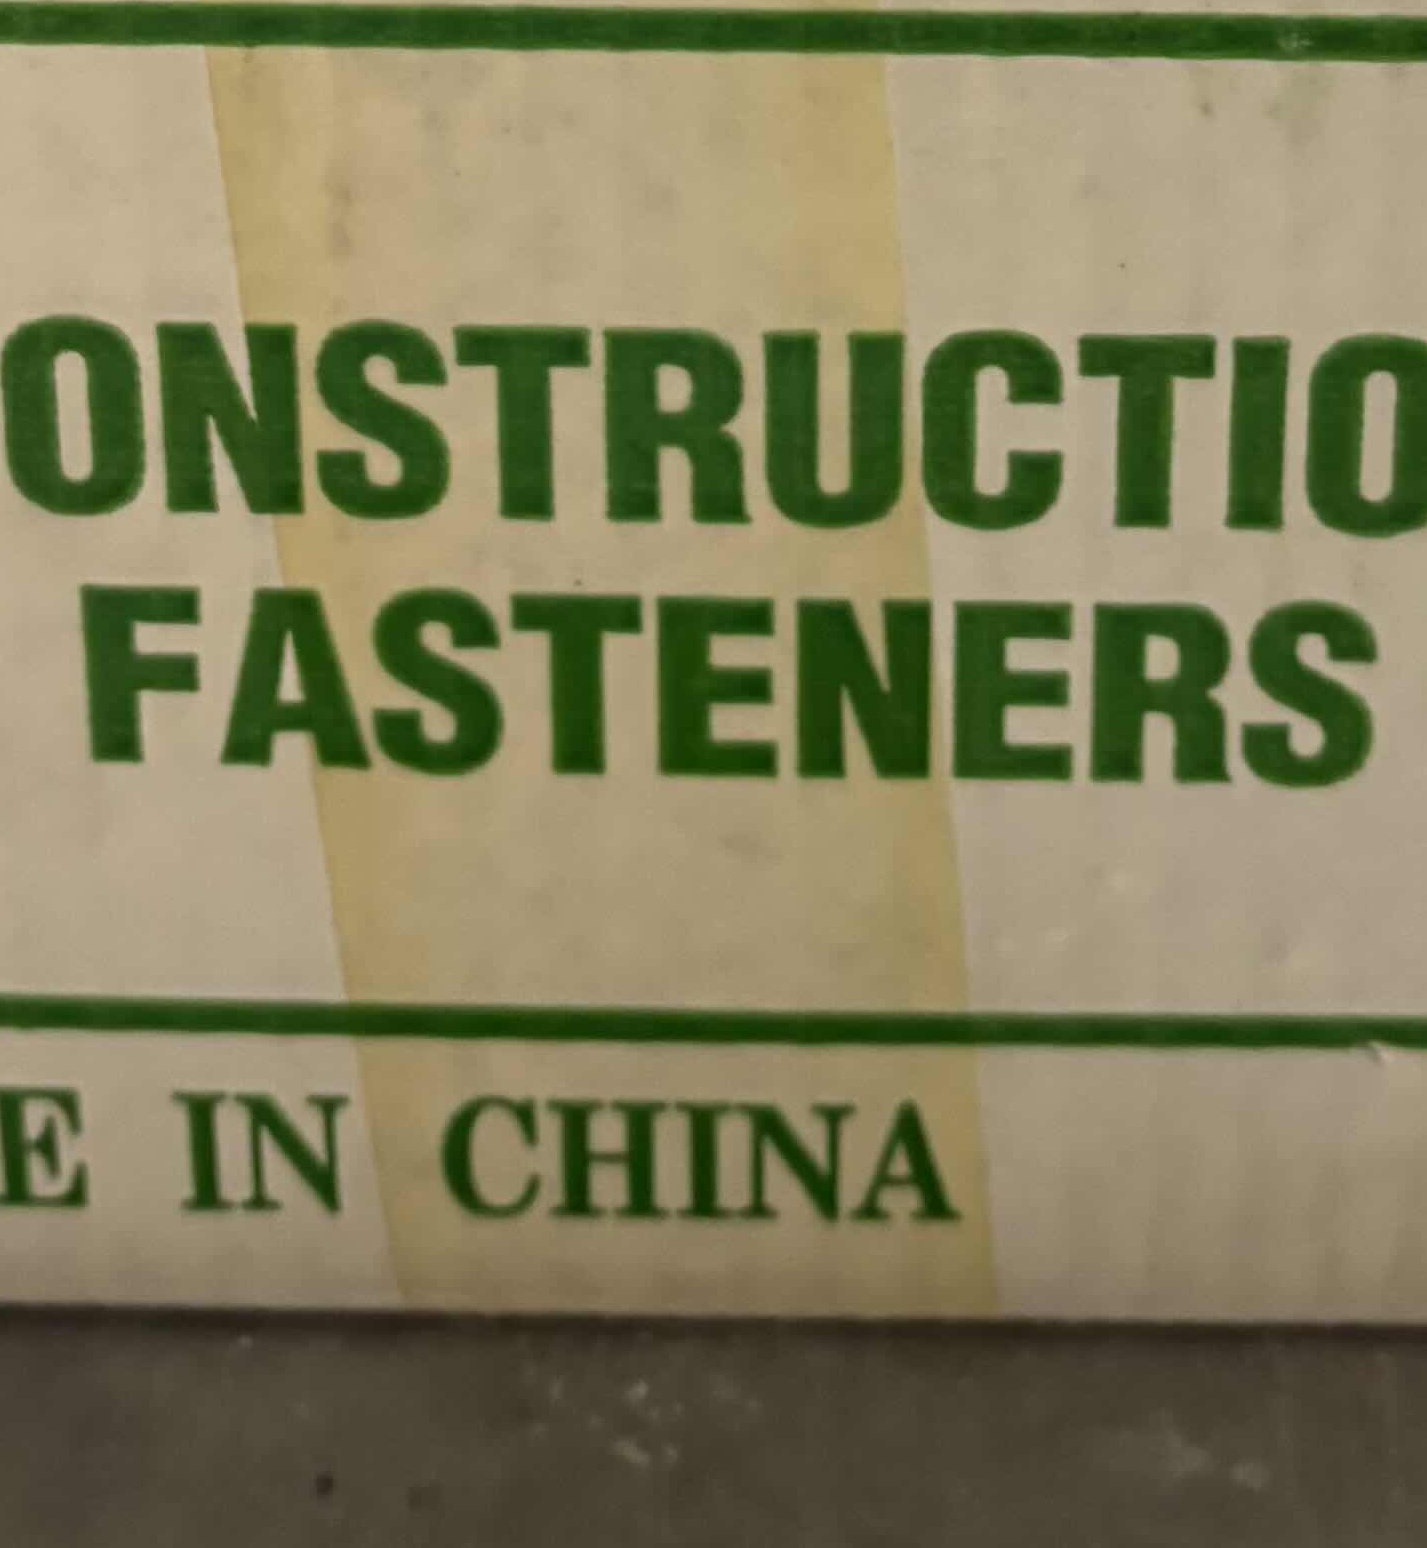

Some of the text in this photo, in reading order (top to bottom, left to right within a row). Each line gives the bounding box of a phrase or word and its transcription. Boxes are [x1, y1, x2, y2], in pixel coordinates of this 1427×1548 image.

[81, 585, 1378, 787] FASTENERS
[175, 1091, 349, 1211] IN
[441, 1096, 959, 1222] CHINA
